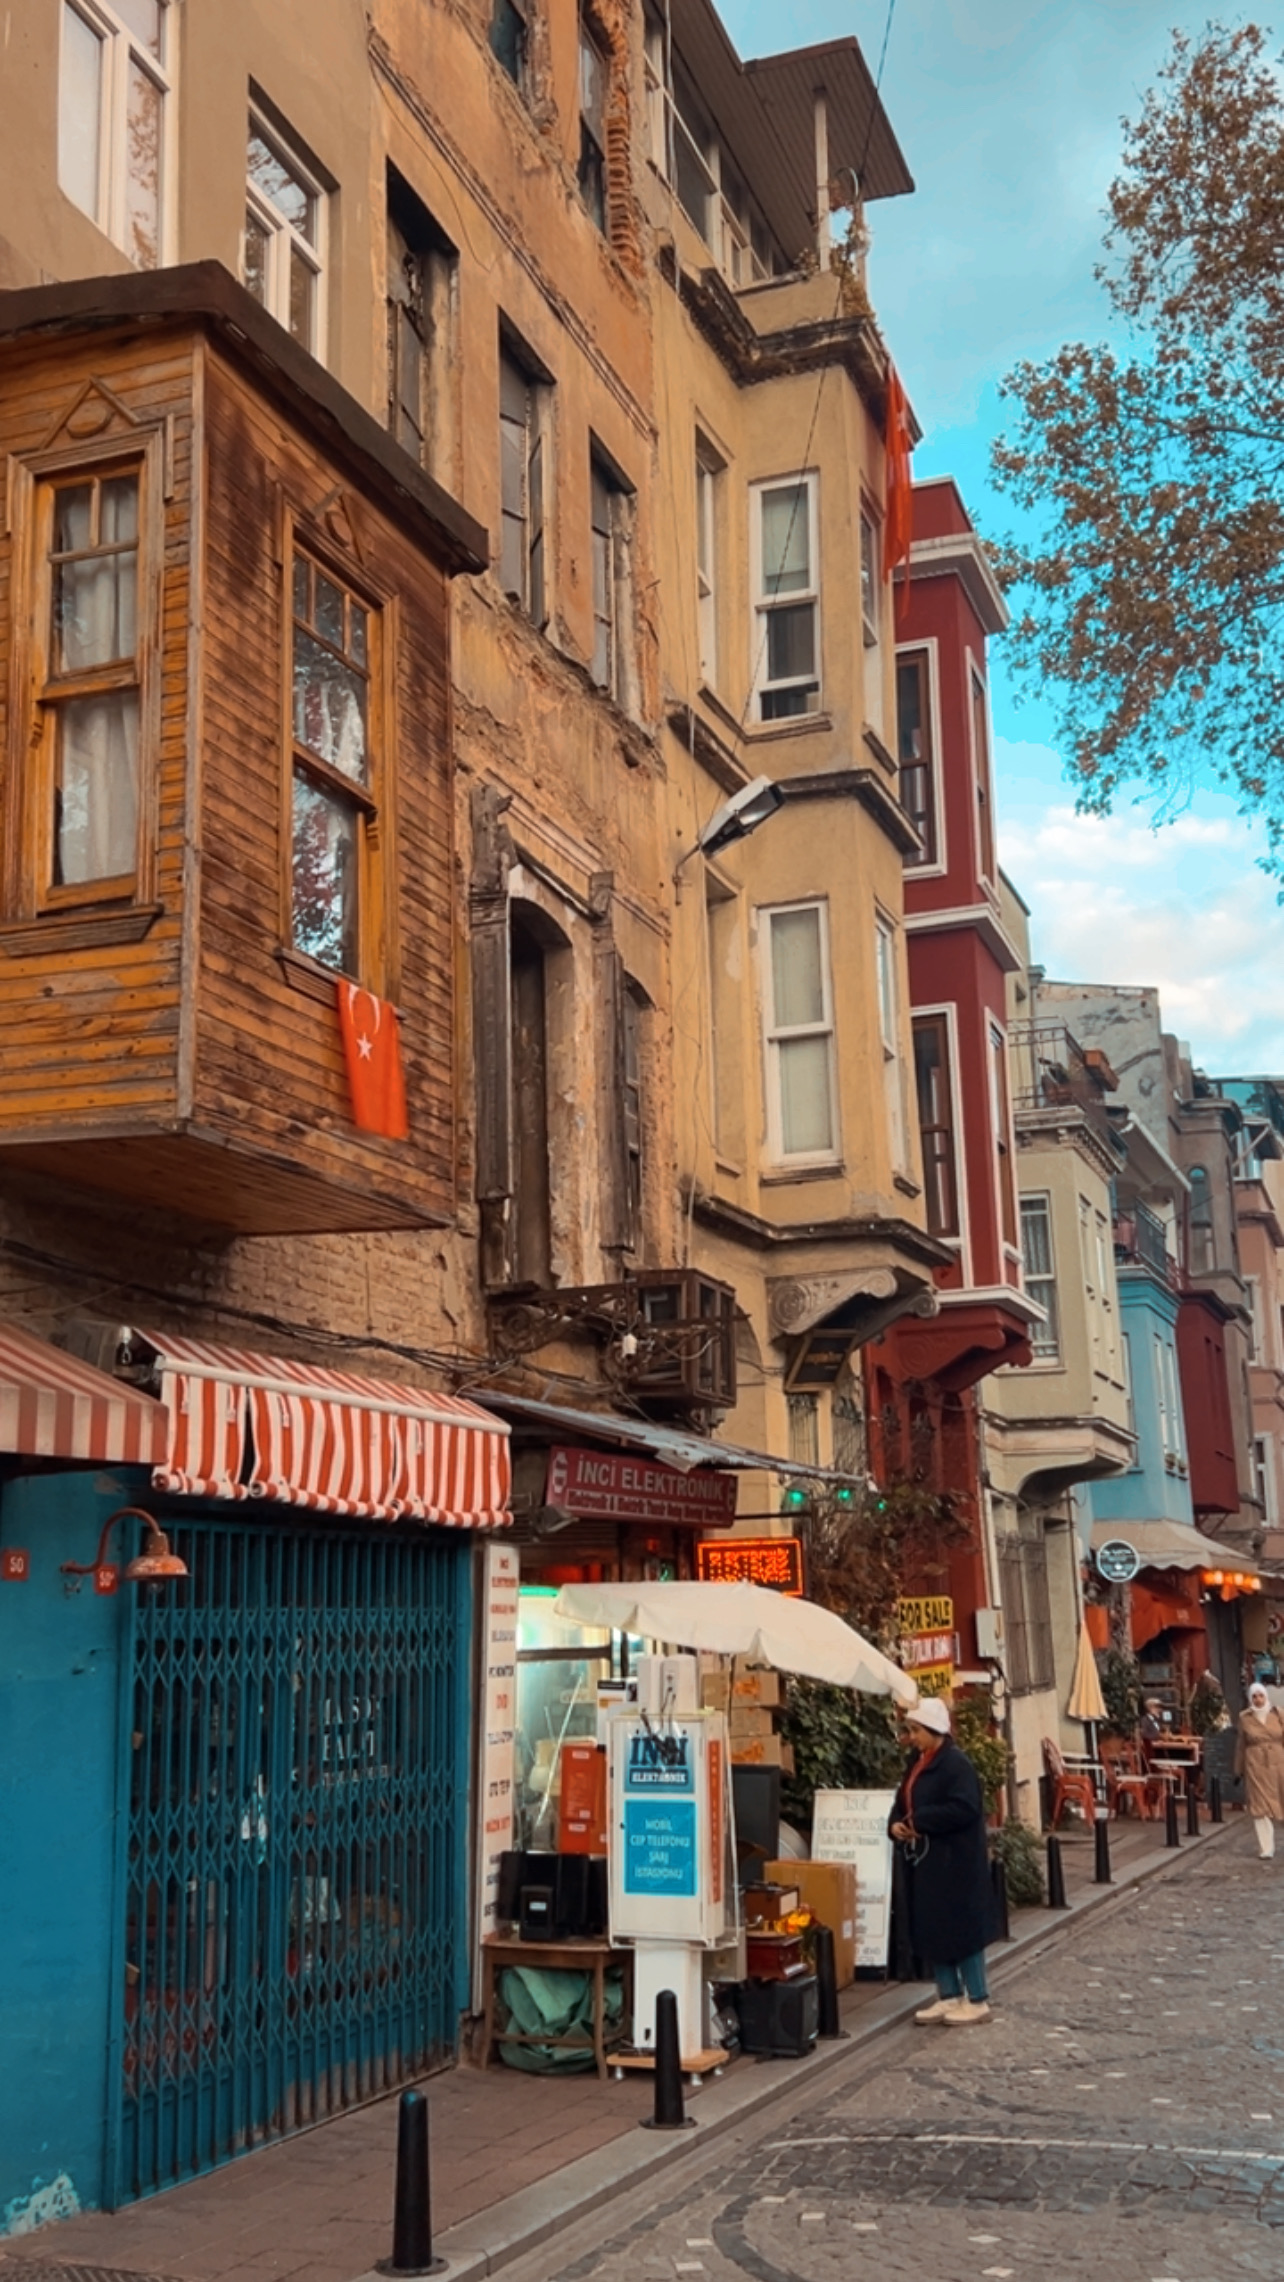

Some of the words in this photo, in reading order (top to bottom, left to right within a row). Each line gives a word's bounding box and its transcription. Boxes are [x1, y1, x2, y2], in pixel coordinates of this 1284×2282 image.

[576, 1454, 617, 1487] İNCİ
[621, 1466, 724, 1500] ELEKTRONİK
[10, 1556, 24, 1573] 50
[900, 1602, 924, 1630] FOR
[925, 1600, 951, 1629] SALE
[629, 1728, 689, 1766] İNİ
[629, 1835, 646, 1847] CEP
[646, 1835, 691, 1848] TELEFONU
